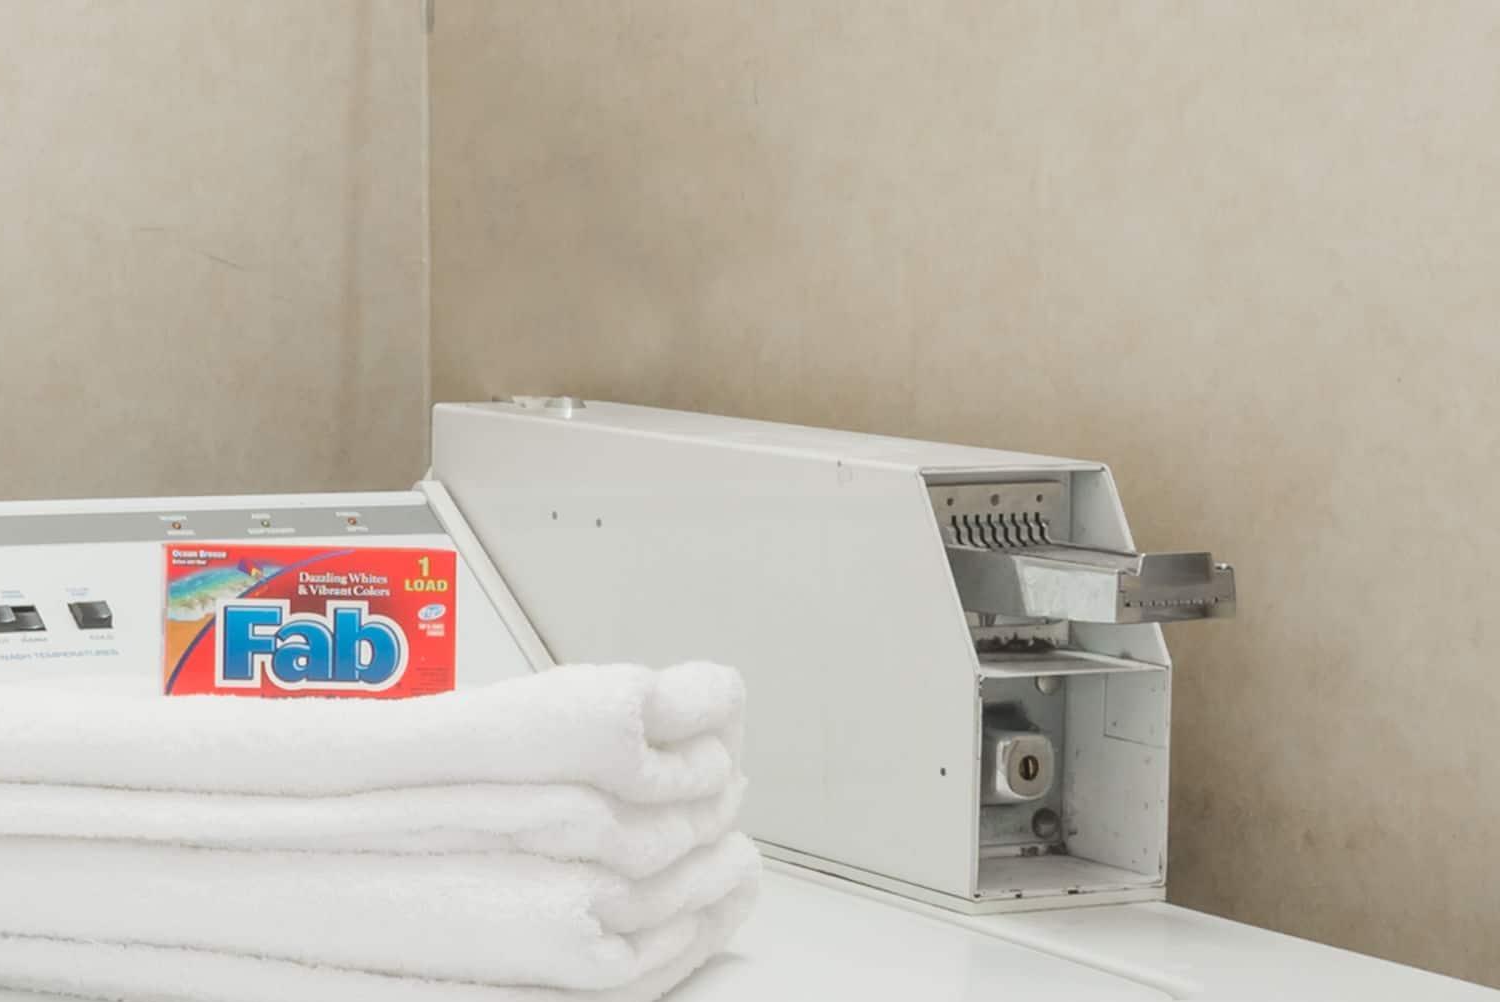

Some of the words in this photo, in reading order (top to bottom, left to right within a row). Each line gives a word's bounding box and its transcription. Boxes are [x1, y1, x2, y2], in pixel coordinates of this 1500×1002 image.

[417, 556, 430, 577] 1
[299, 572, 348, 585] Dazzling
[348, 573, 388, 584] Whites
[298, 585, 308, 596] &
[308, 585, 352, 596] Vibrant
[353, 585, 390, 597] Colors
[404, 579, 448, 592] LOAD
[221, 603, 402, 685] Fab
